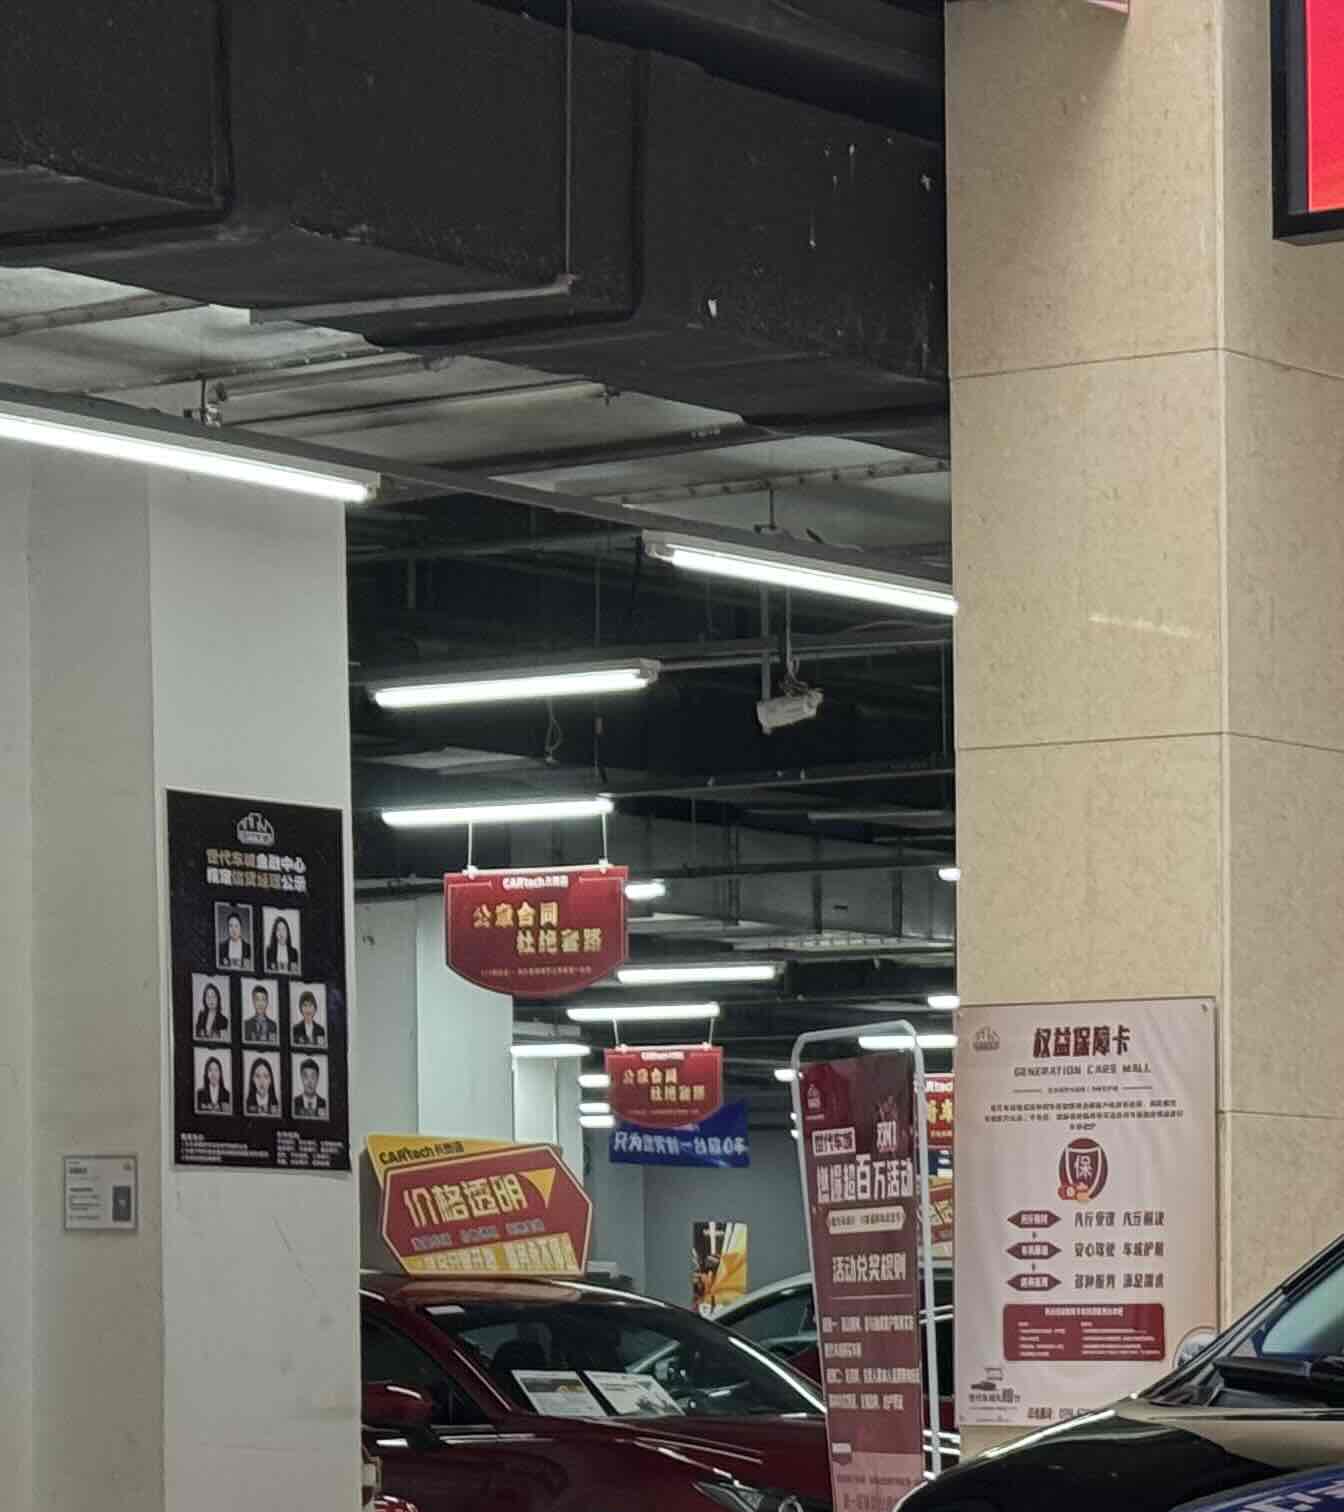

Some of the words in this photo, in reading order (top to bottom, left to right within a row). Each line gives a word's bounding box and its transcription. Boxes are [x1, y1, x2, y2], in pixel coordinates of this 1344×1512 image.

[1033, 1025, 1131, 1058] 权益保障卡
[1014, 1065, 1082, 1077] GENERATION
[1087, 1064, 1118, 1075] CARS
[1122, 1063, 1152, 1073] MALL
[1074, 1155, 1094, 1179] 保
[403, 1174, 528, 1229] 价格透明
[832, 1253, 907, 1283] 活动兑奖规则
